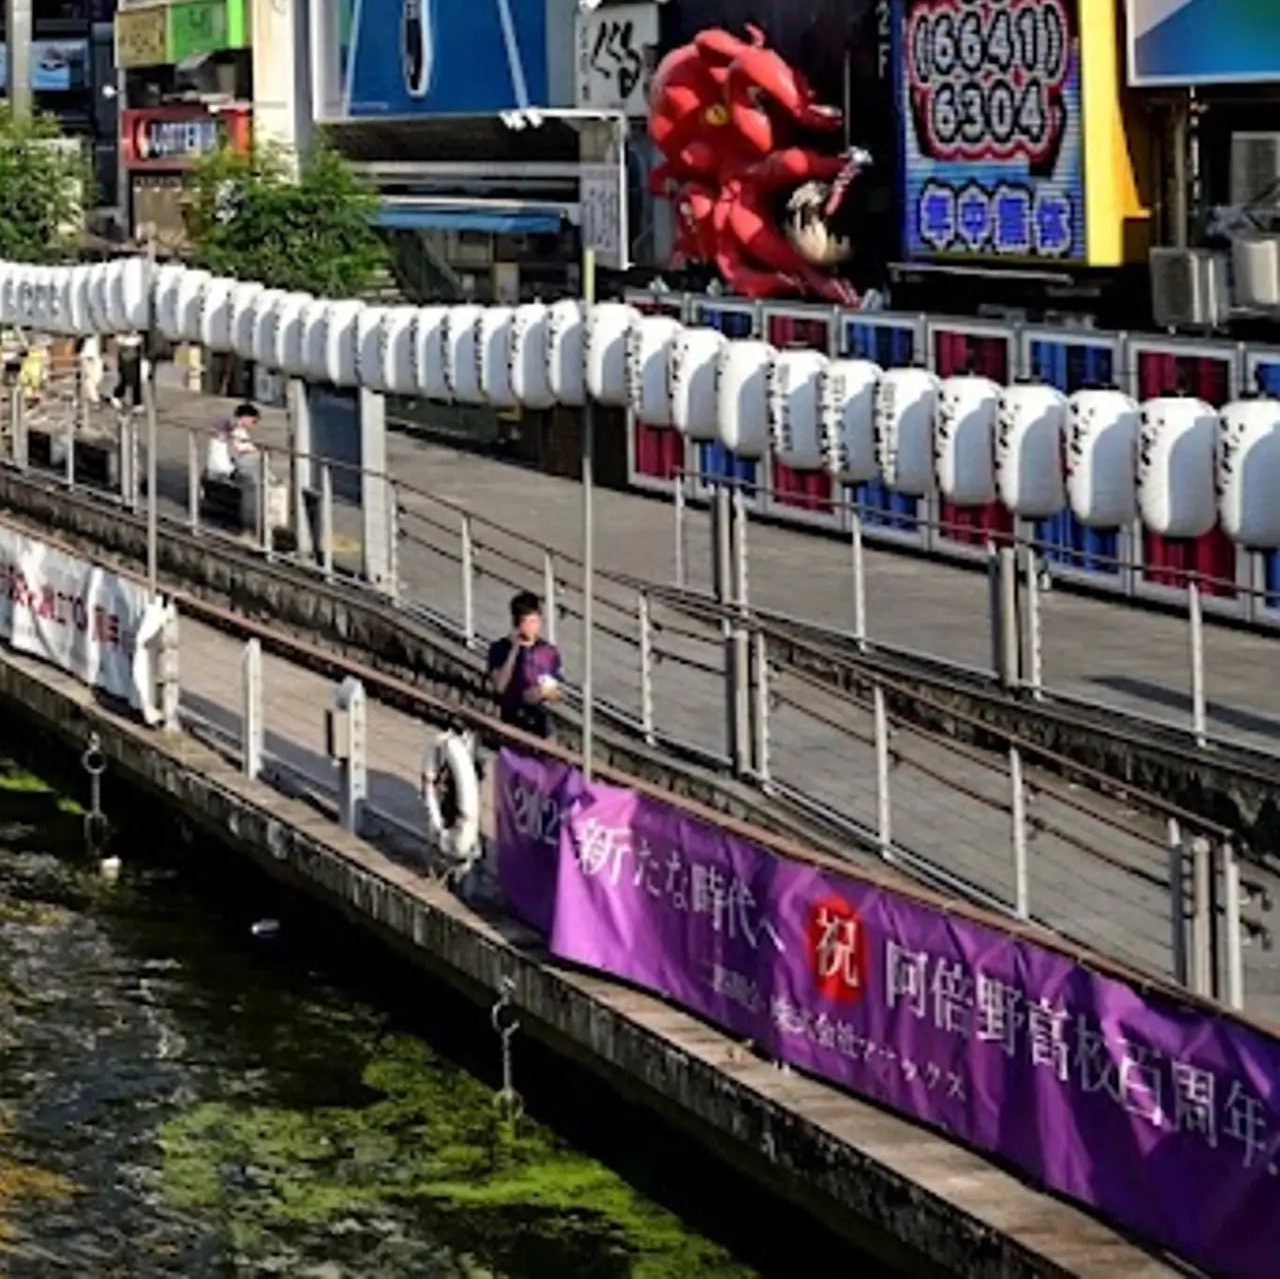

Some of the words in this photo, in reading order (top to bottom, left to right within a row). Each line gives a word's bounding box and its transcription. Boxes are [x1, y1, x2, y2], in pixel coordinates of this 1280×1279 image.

[912, 3, 1064, 83] (6641)
[932, 83, 1050, 145] 6304
[576, 816, 787, 953] 新たな時代へ
[814, 908, 861, 988] 祝
[886, 938, 1267, 1169] 阿倍野高校百周年
